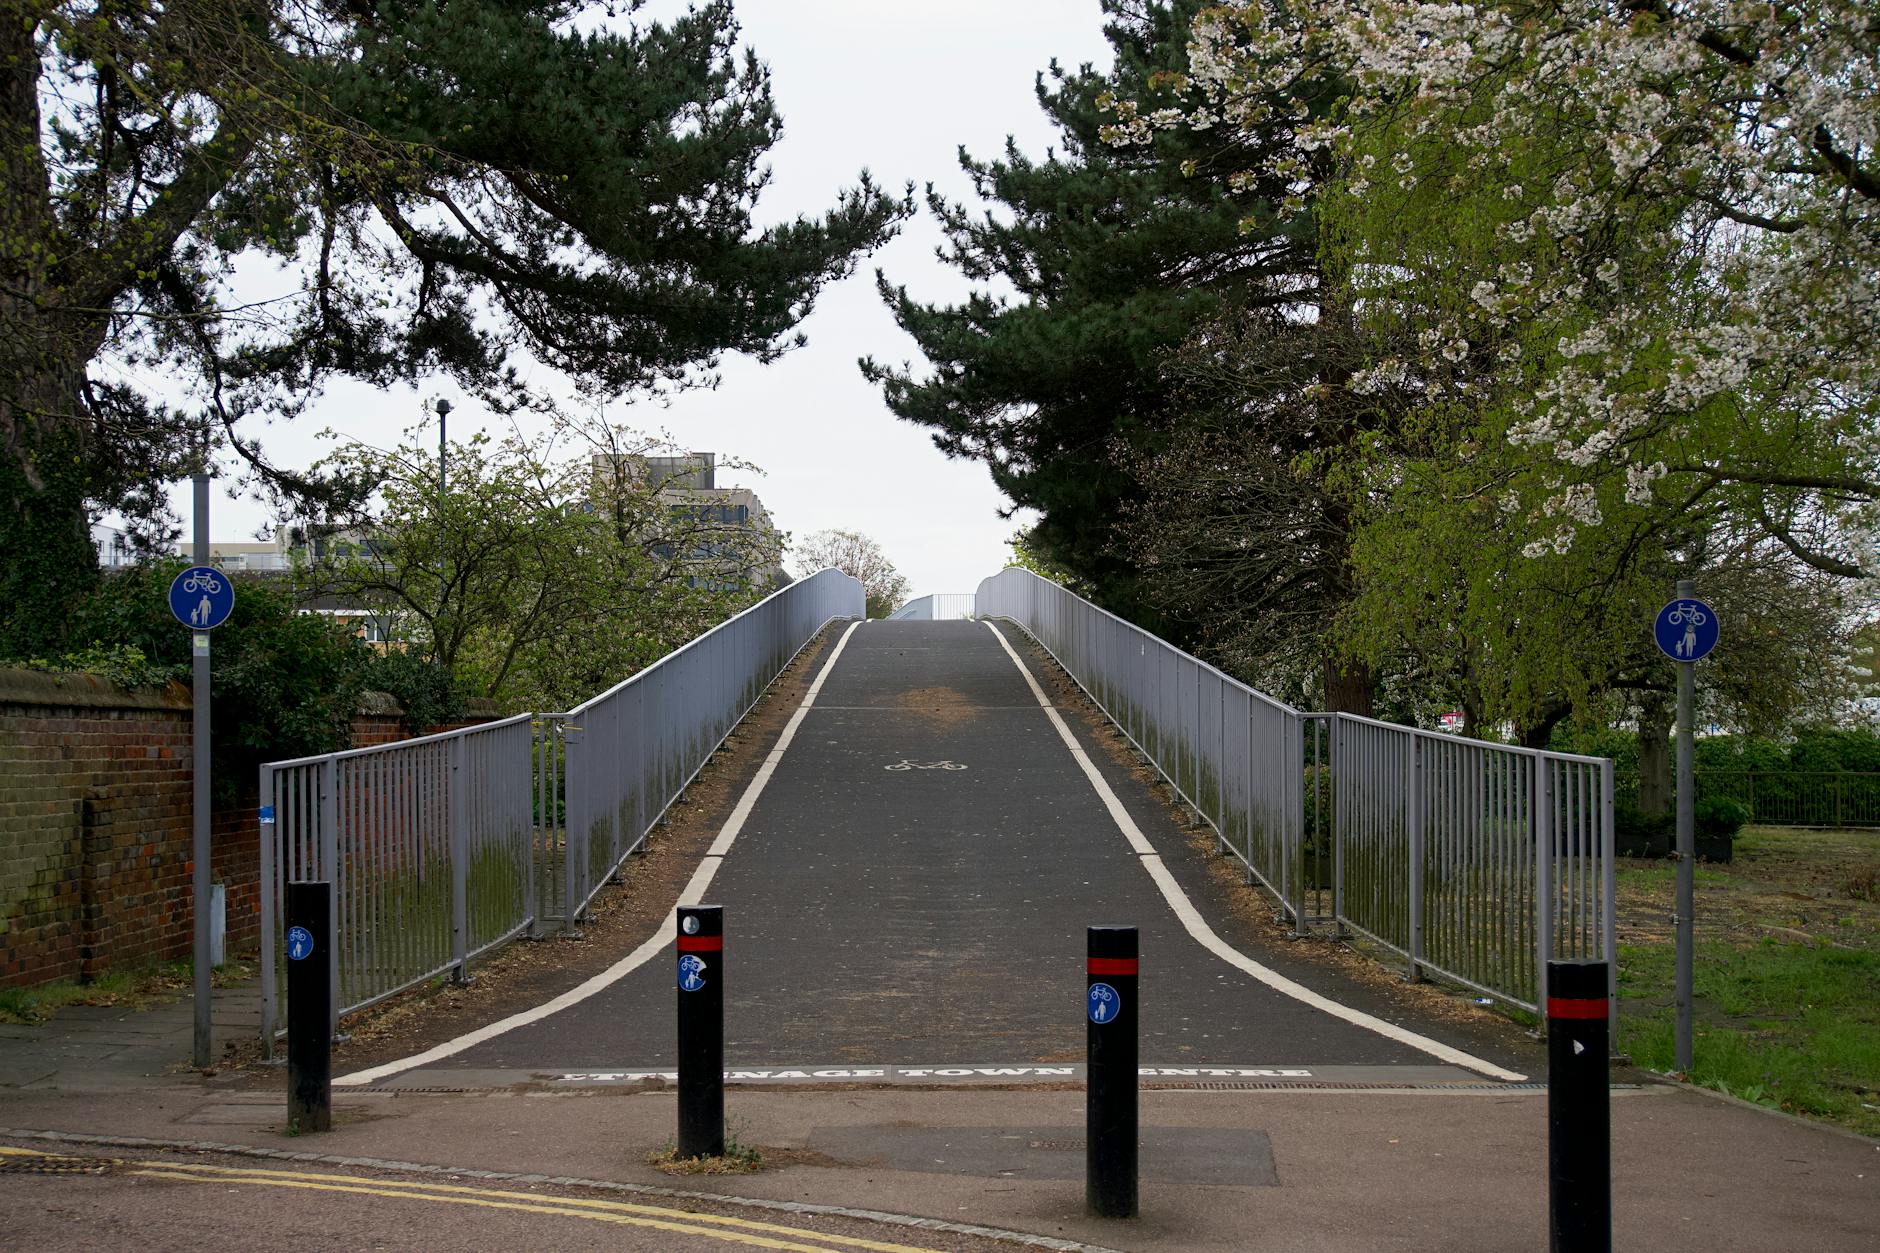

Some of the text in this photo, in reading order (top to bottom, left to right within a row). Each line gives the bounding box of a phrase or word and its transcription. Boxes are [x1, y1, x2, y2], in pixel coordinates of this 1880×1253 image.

[557, 1067, 1312, 1081] STEVNAGE TOWN ENTRE
